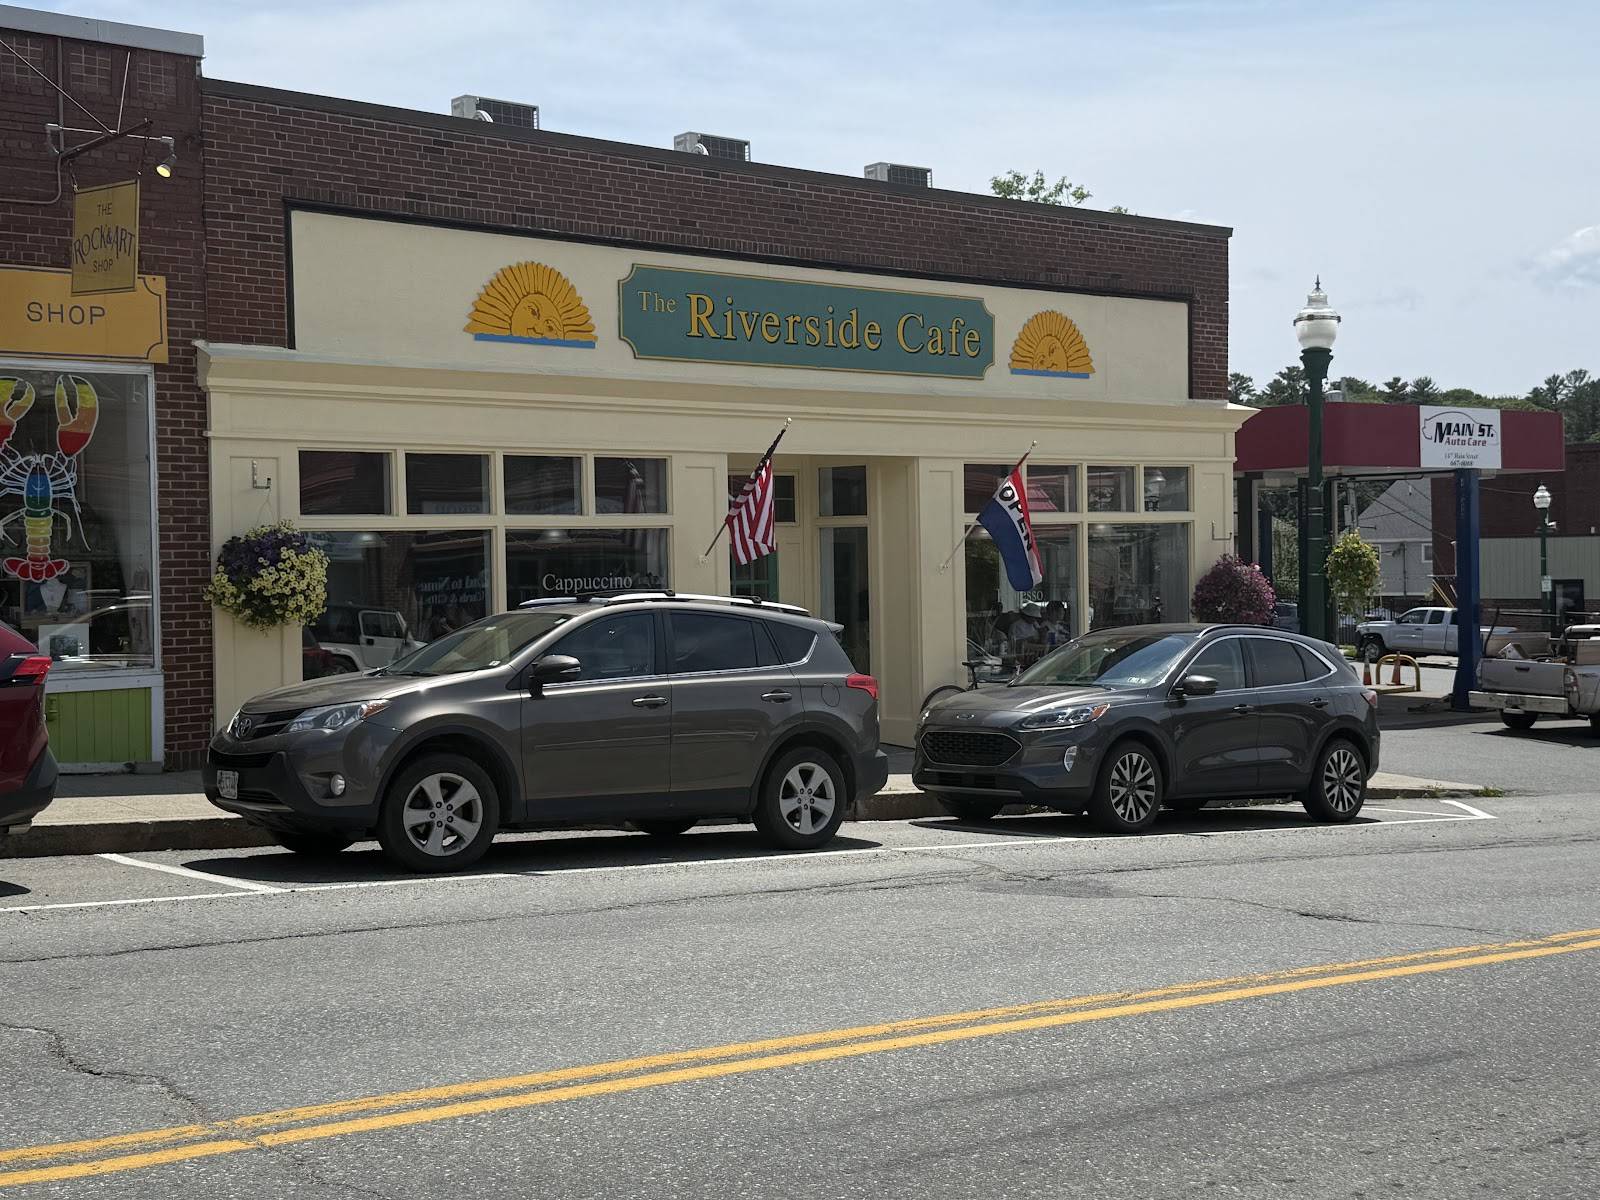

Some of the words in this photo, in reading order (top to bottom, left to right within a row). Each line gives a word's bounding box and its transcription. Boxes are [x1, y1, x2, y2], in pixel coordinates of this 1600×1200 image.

[97, 203, 112, 216] THE
[93, 259, 113, 273] SHOP
[27, 301, 105, 325] SHOP
[637, 290, 677, 313] The
[686, 293, 882, 350] Riverside
[896, 313, 982, 358] Cafe
[1433, 422, 1475, 443] MAIN
[1478, 424, 1494, 437] ST.
[999, 486, 1032, 551] OPEN
[542, 572, 633, 594] Cappuccino
